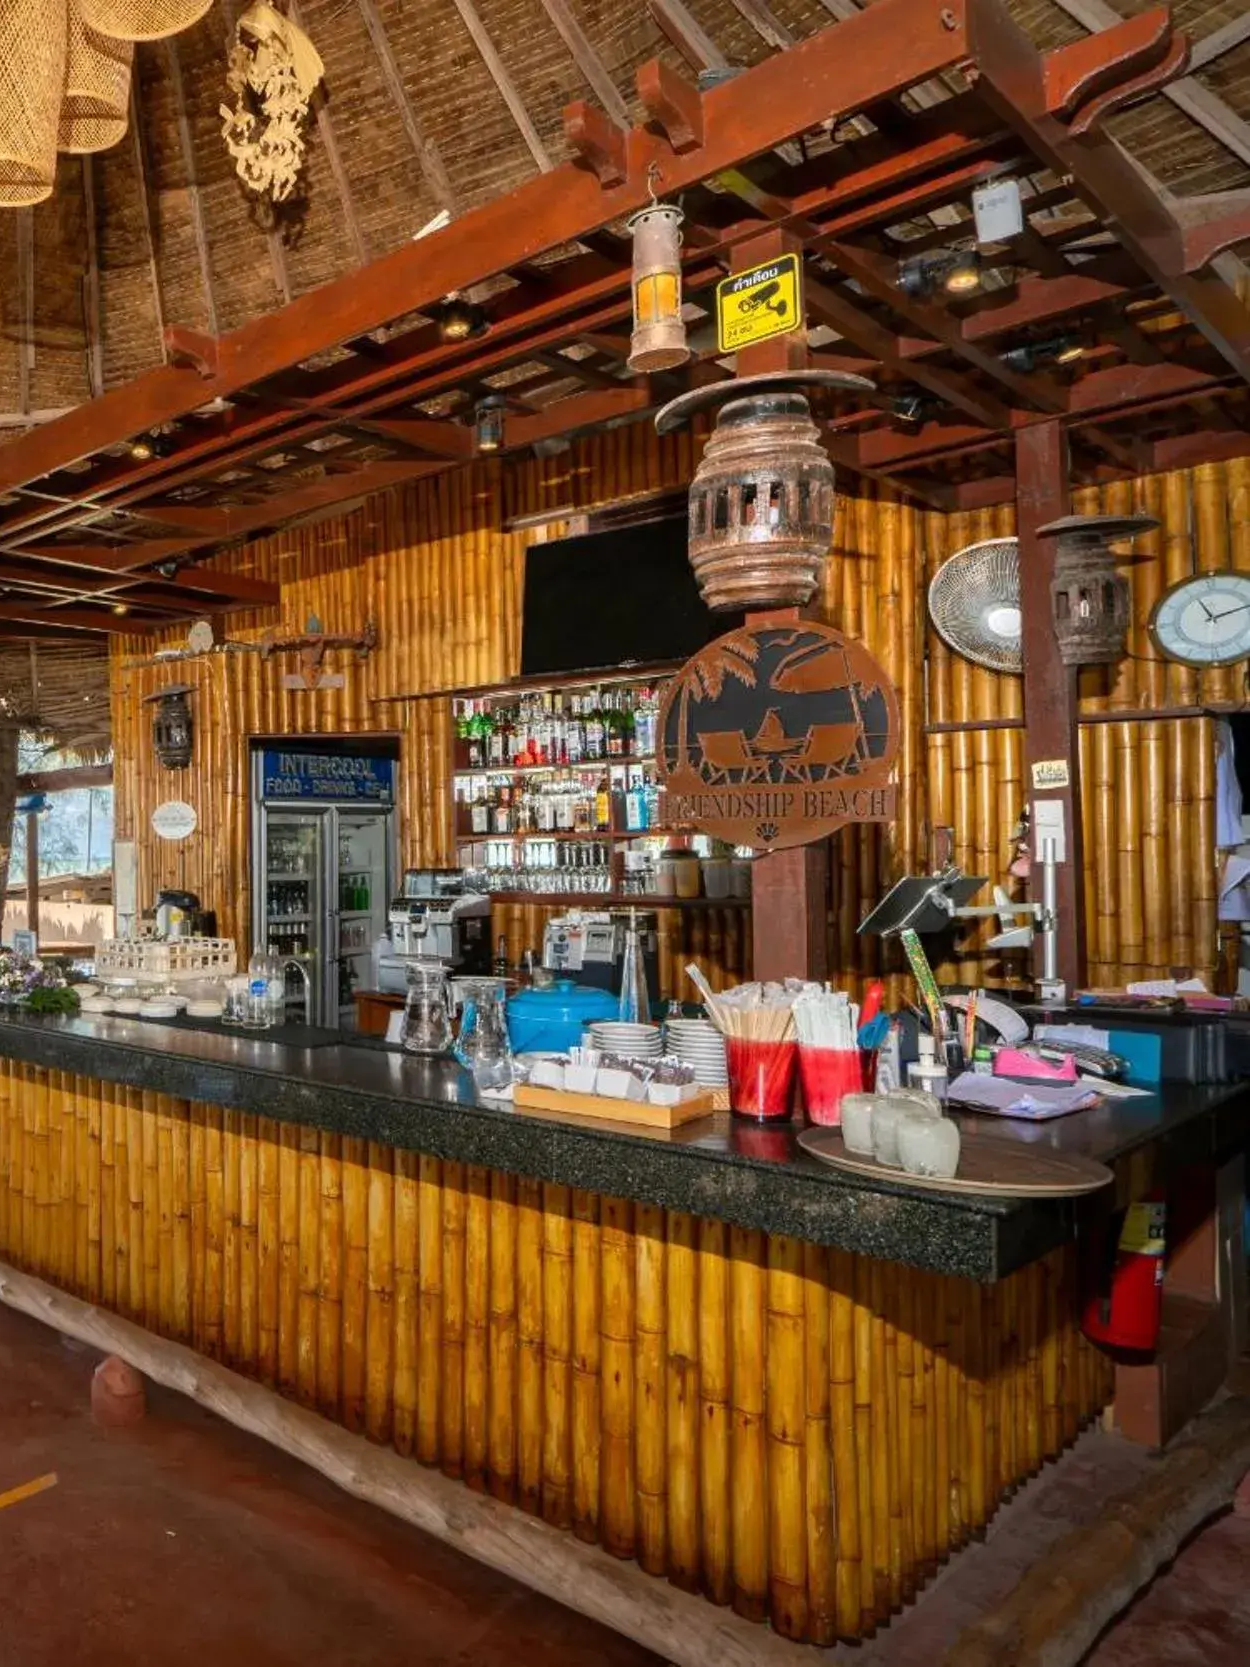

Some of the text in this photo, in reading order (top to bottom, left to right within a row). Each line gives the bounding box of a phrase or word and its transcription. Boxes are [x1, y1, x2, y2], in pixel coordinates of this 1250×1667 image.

[733, 266, 779, 292] คำเตือน
[279, 754, 377, 780] INTERCOOL
[266, 777, 301, 794] FOOD
[664, 789, 888, 818] FRIENDSHIP BEACH
